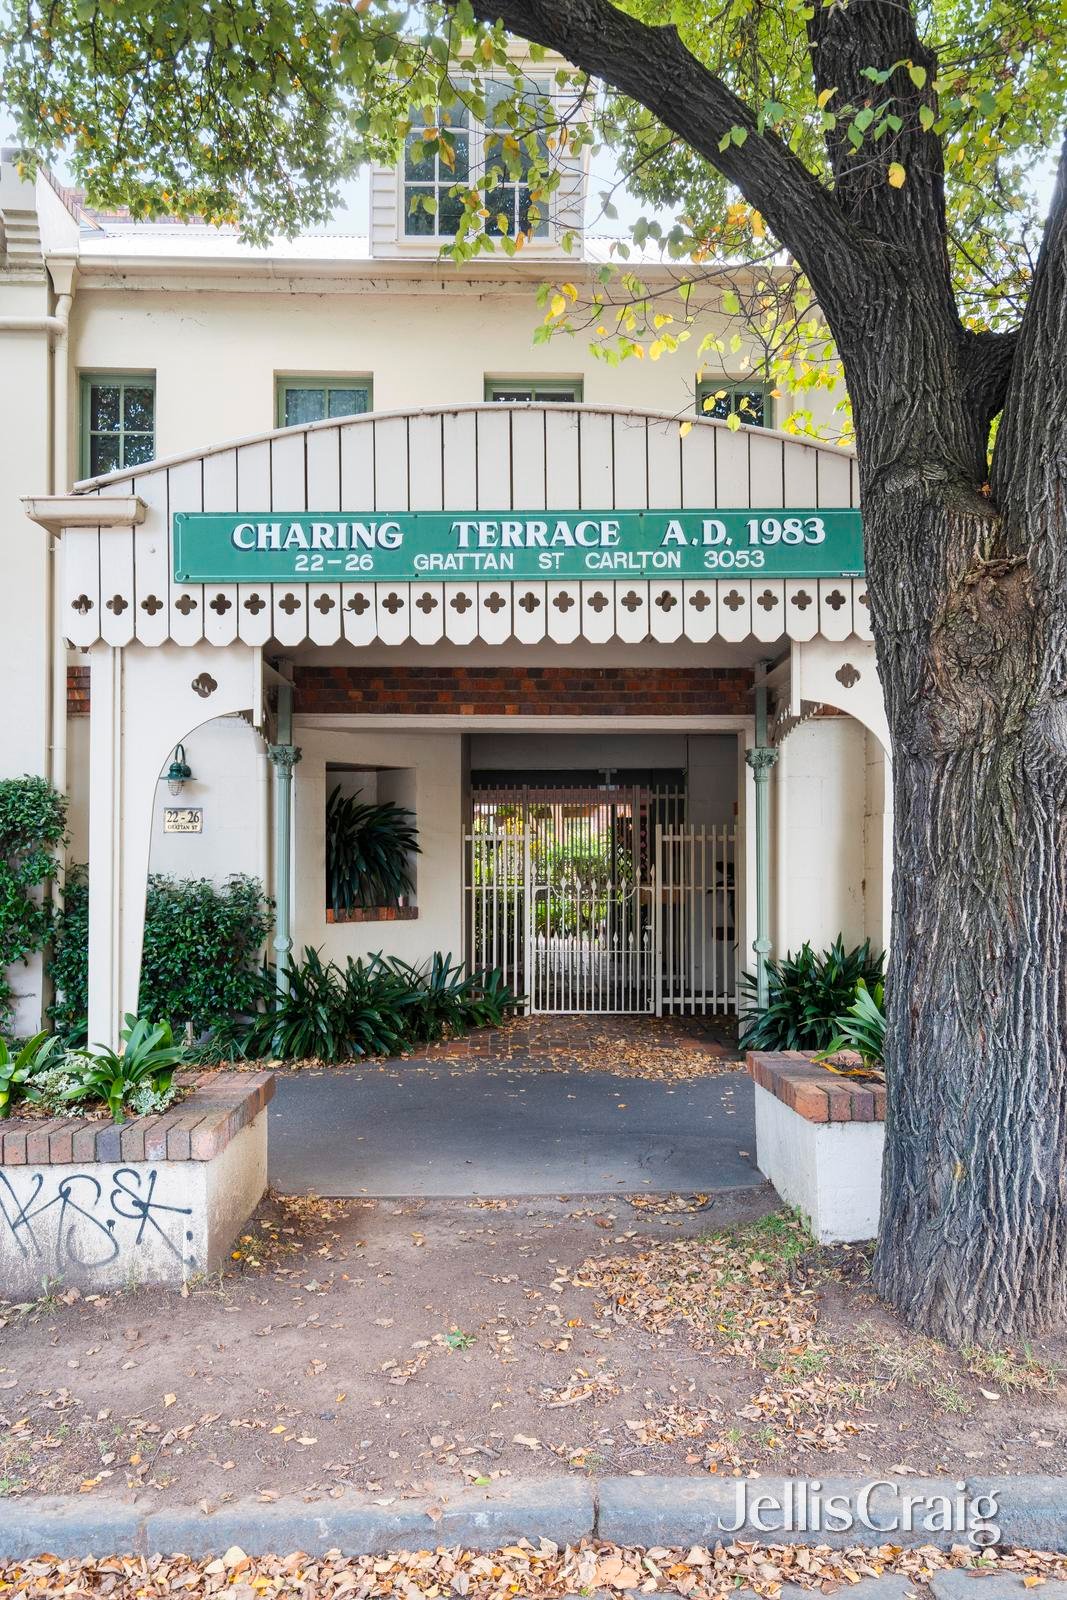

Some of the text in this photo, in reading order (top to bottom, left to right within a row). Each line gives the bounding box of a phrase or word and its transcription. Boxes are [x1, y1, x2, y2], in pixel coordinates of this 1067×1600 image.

[232, 517, 826, 550] CHARING TERRACE A.D. 1983
[413, 553, 514, 571] GRATTAN
[538, 552, 564, 569] ST
[585, 551, 682, 569] CARLTON
[703, 550, 765, 568] 3053
